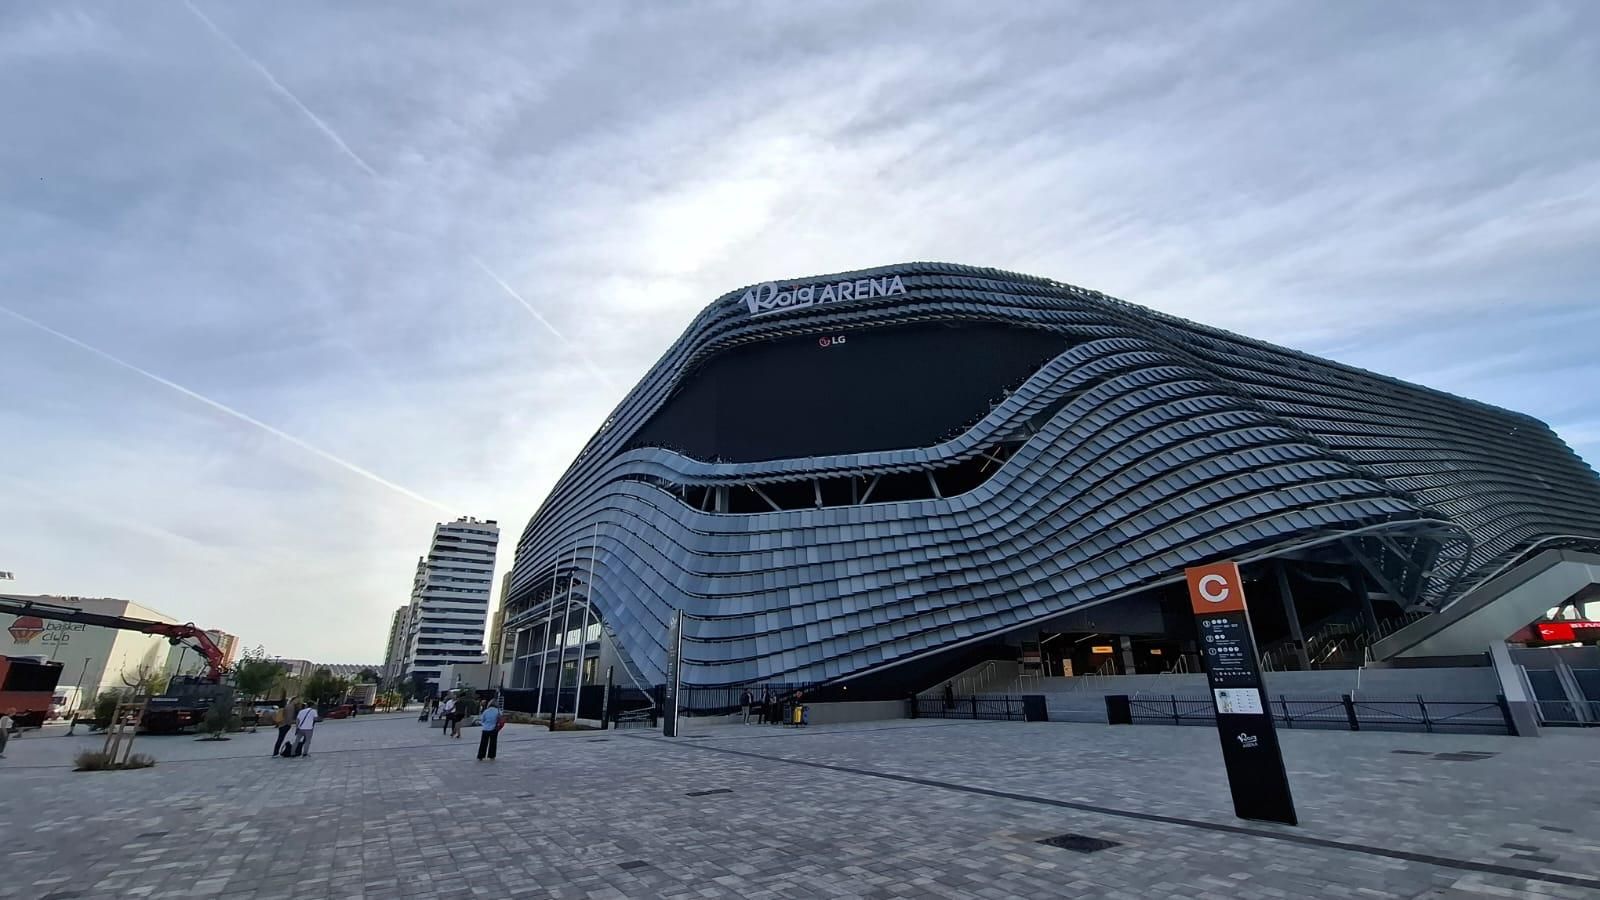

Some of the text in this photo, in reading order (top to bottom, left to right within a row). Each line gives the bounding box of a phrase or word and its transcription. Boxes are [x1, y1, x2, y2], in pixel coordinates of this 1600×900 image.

[738, 275, 907, 318] Roig ARENA
[832, 335, 846, 344] LG
[1199, 574, 1229, 602] C
[46, 621, 87, 632] basket
[41, 632, 70, 641] club
